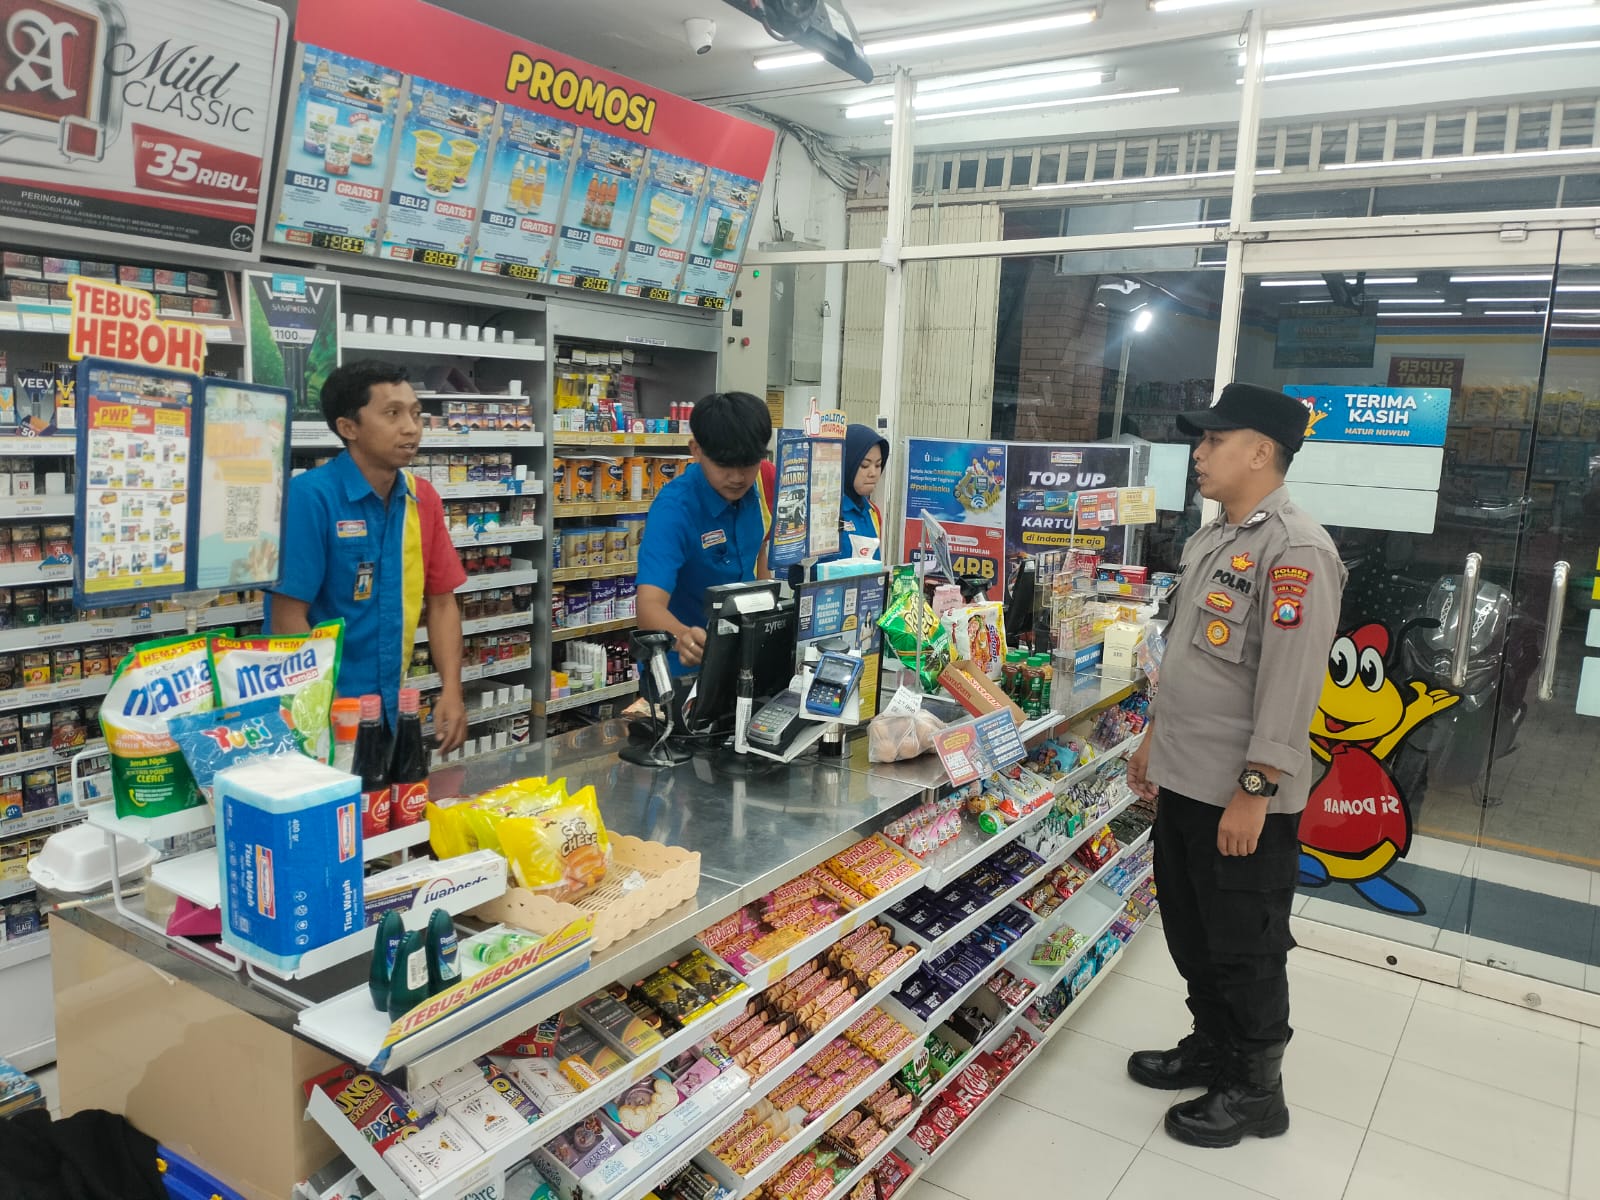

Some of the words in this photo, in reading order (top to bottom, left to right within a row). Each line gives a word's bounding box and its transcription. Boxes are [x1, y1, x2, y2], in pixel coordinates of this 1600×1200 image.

[104, 39, 241, 99] Mild
[507, 53, 656, 134] PROMOSI
[122, 80, 254, 132] CLASSIC
[147, 143, 202, 181] 35
[196, 168, 248, 191] RIBU
[234, 232, 252, 243] 21+
[75, 283, 152, 321] TEBUS
[275, 329, 298, 340] 1100
[74, 317, 203, 373] HEBOH!
[18, 378, 54, 389] VEEV
[1344, 394, 1417, 409] TERIMA
[101, 408, 130, 422] PWP
[820, 413, 845, 425] PALING
[1349, 409, 1409, 424] KASIH
[821, 425, 845, 436] MURAH
[1344, 427, 1374, 436] MATUR
[1375, 428, 1410, 437] NUWUN
[1029, 471, 1071, 487] TOP
[1076, 472, 1106, 487] UP
[1022, 517, 1072, 530] KARTU
[970, 547, 990, 555] MURAH
[953, 557, 995, 578] 4RB
[1274, 567, 1308, 577] POLRES
[1212, 569, 1252, 594] POLRI
[764, 618, 786, 635] zyrex
[143, 647, 185, 662] HEMAT
[236, 648, 317, 698] mama
[136, 774, 165, 783] CLEAN
[408, 794, 429, 805] ABC
[7, 807, 18, 816] 21+
[871, 862, 911, 888] SILVERQUEEN
[341, 879, 352, 909] Wajah
[343, 909, 352, 932] Tisu
[402, 988, 466, 1033] TEBUS
[469, 943, 546, 996] HEBOH!
[335, 1074, 376, 1115] UNO
[349, 1090, 384, 1124] EXPRESS
[776, 1159, 816, 1194] SILVERQUEEN
